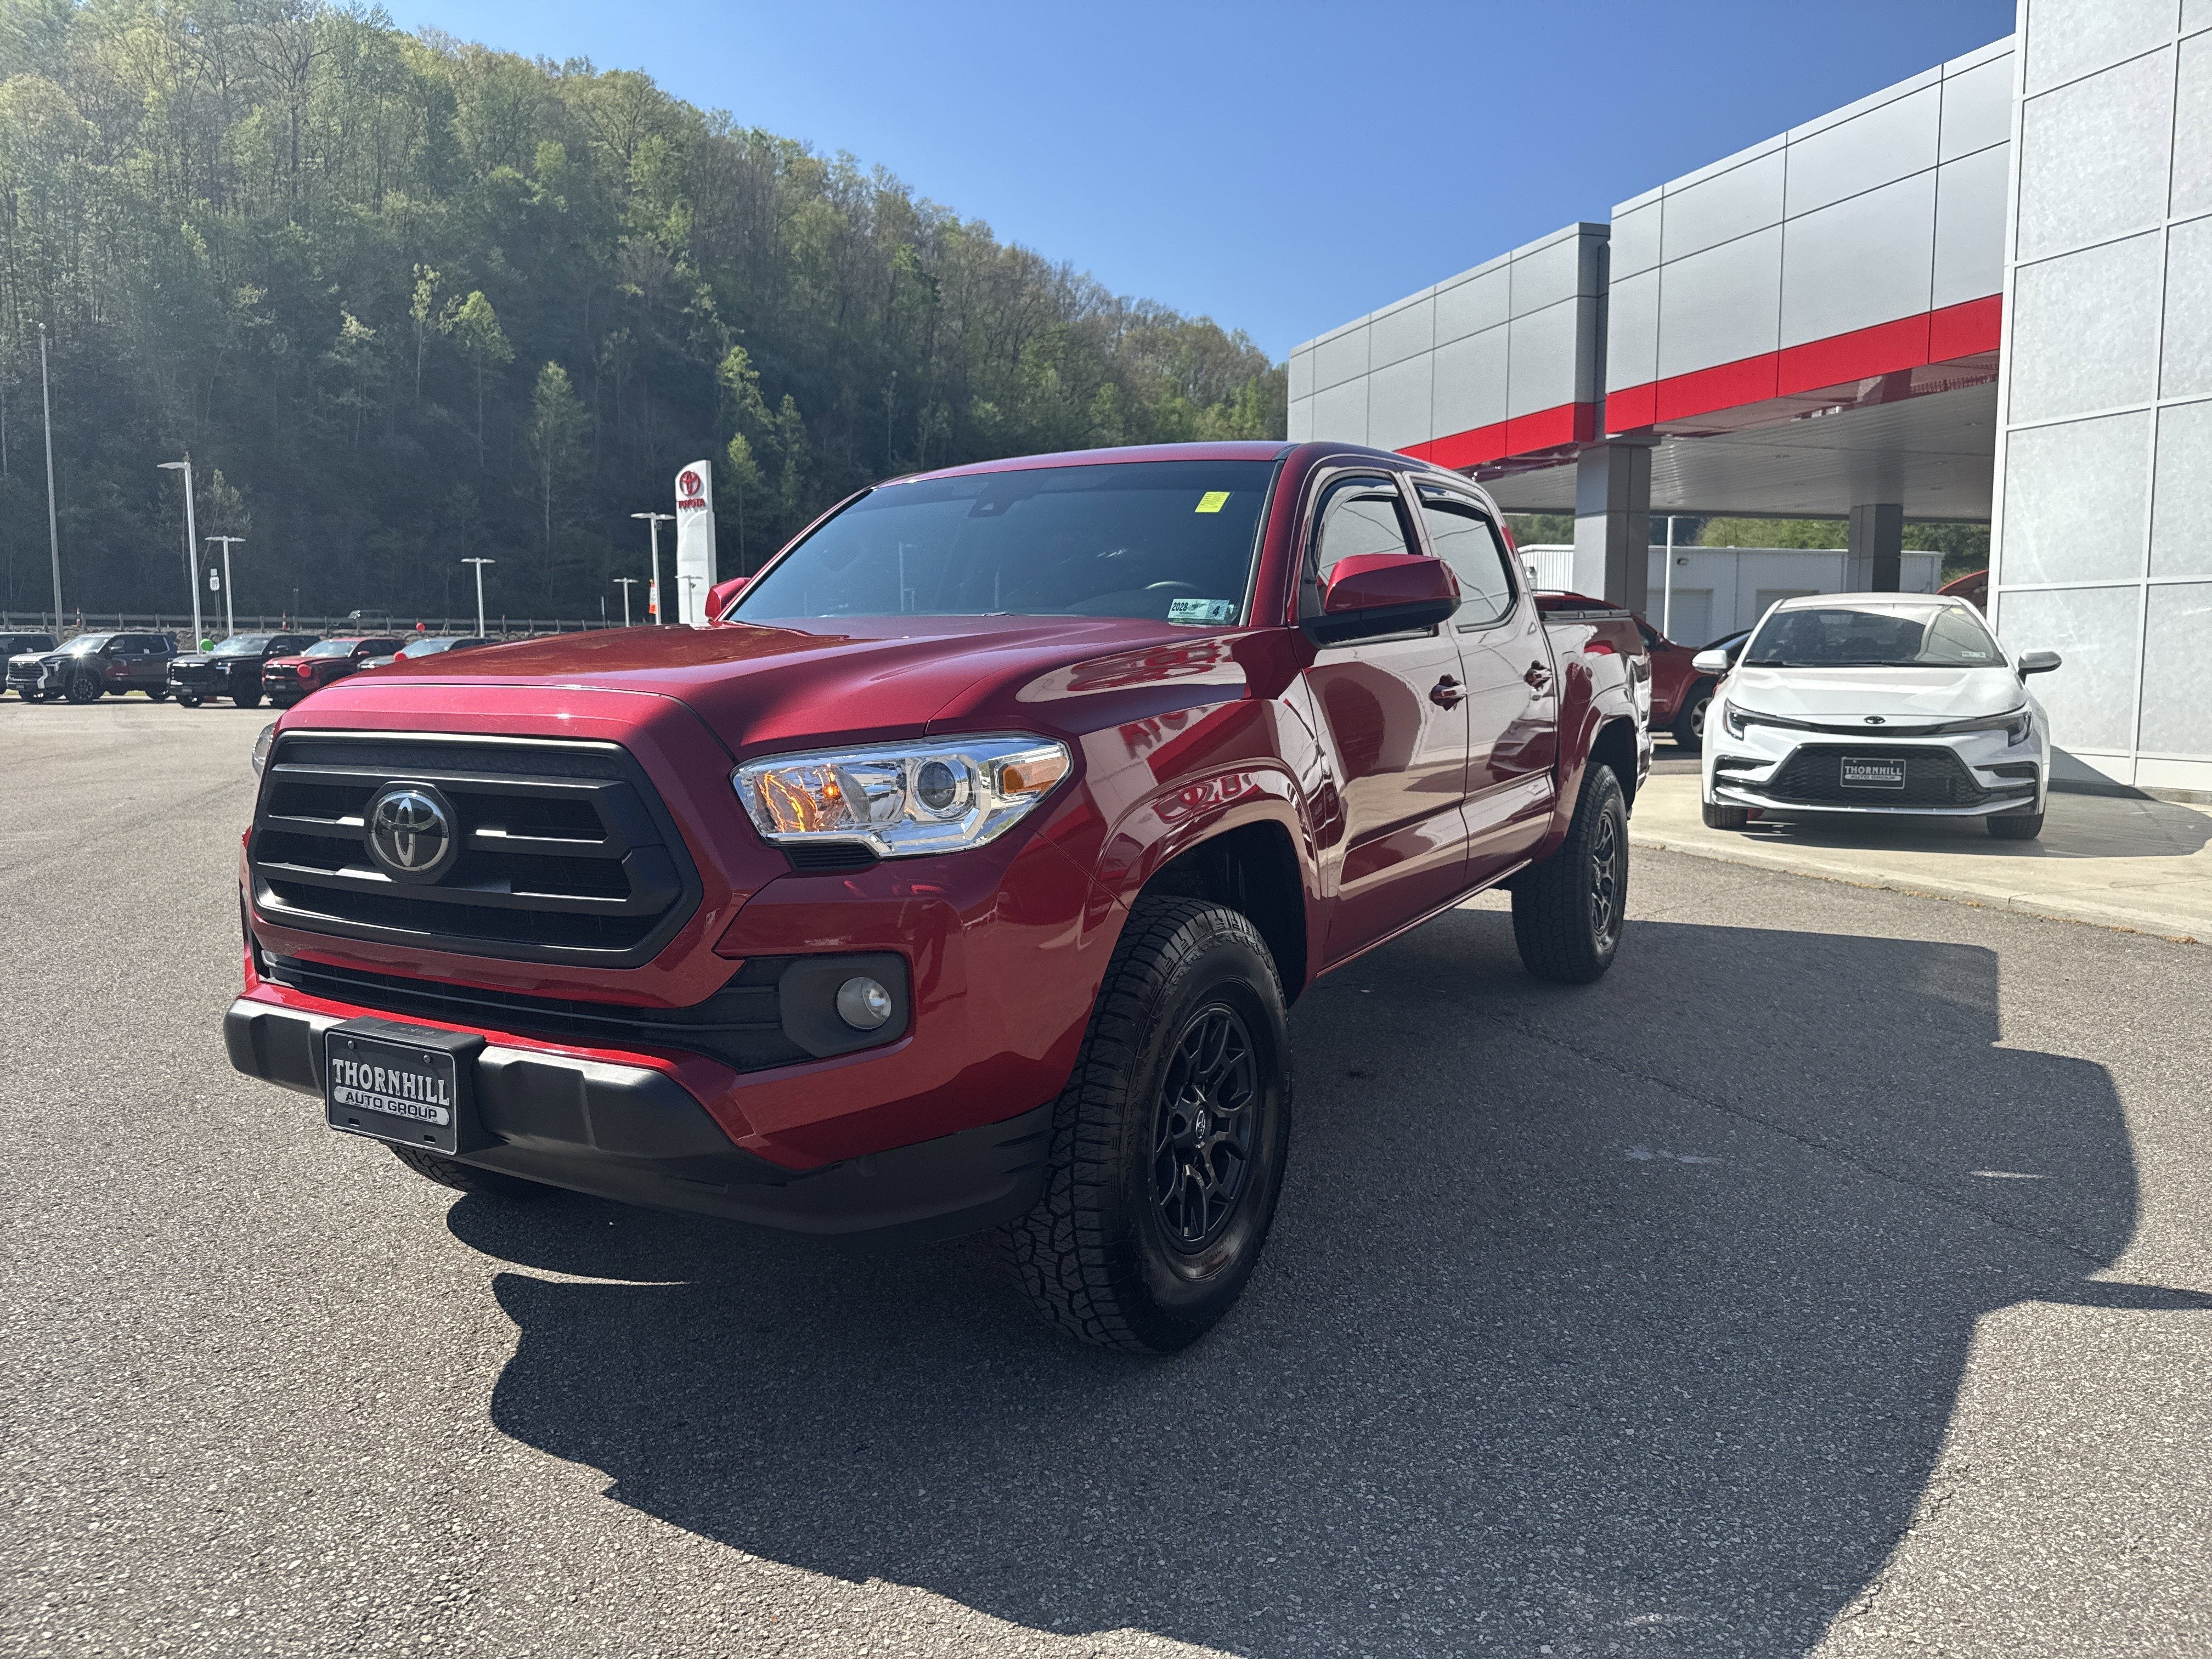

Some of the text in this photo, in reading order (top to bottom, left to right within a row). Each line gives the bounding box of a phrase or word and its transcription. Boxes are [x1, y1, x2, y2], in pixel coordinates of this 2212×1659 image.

[1172, 602, 1188, 612] 2028
[1212, 606, 1220, 617] 4
[1844, 766, 1901, 775] THORNHILL
[332, 1058, 449, 1106] THORNHILL
[345, 1091, 437, 1120] AUTO GROUP
